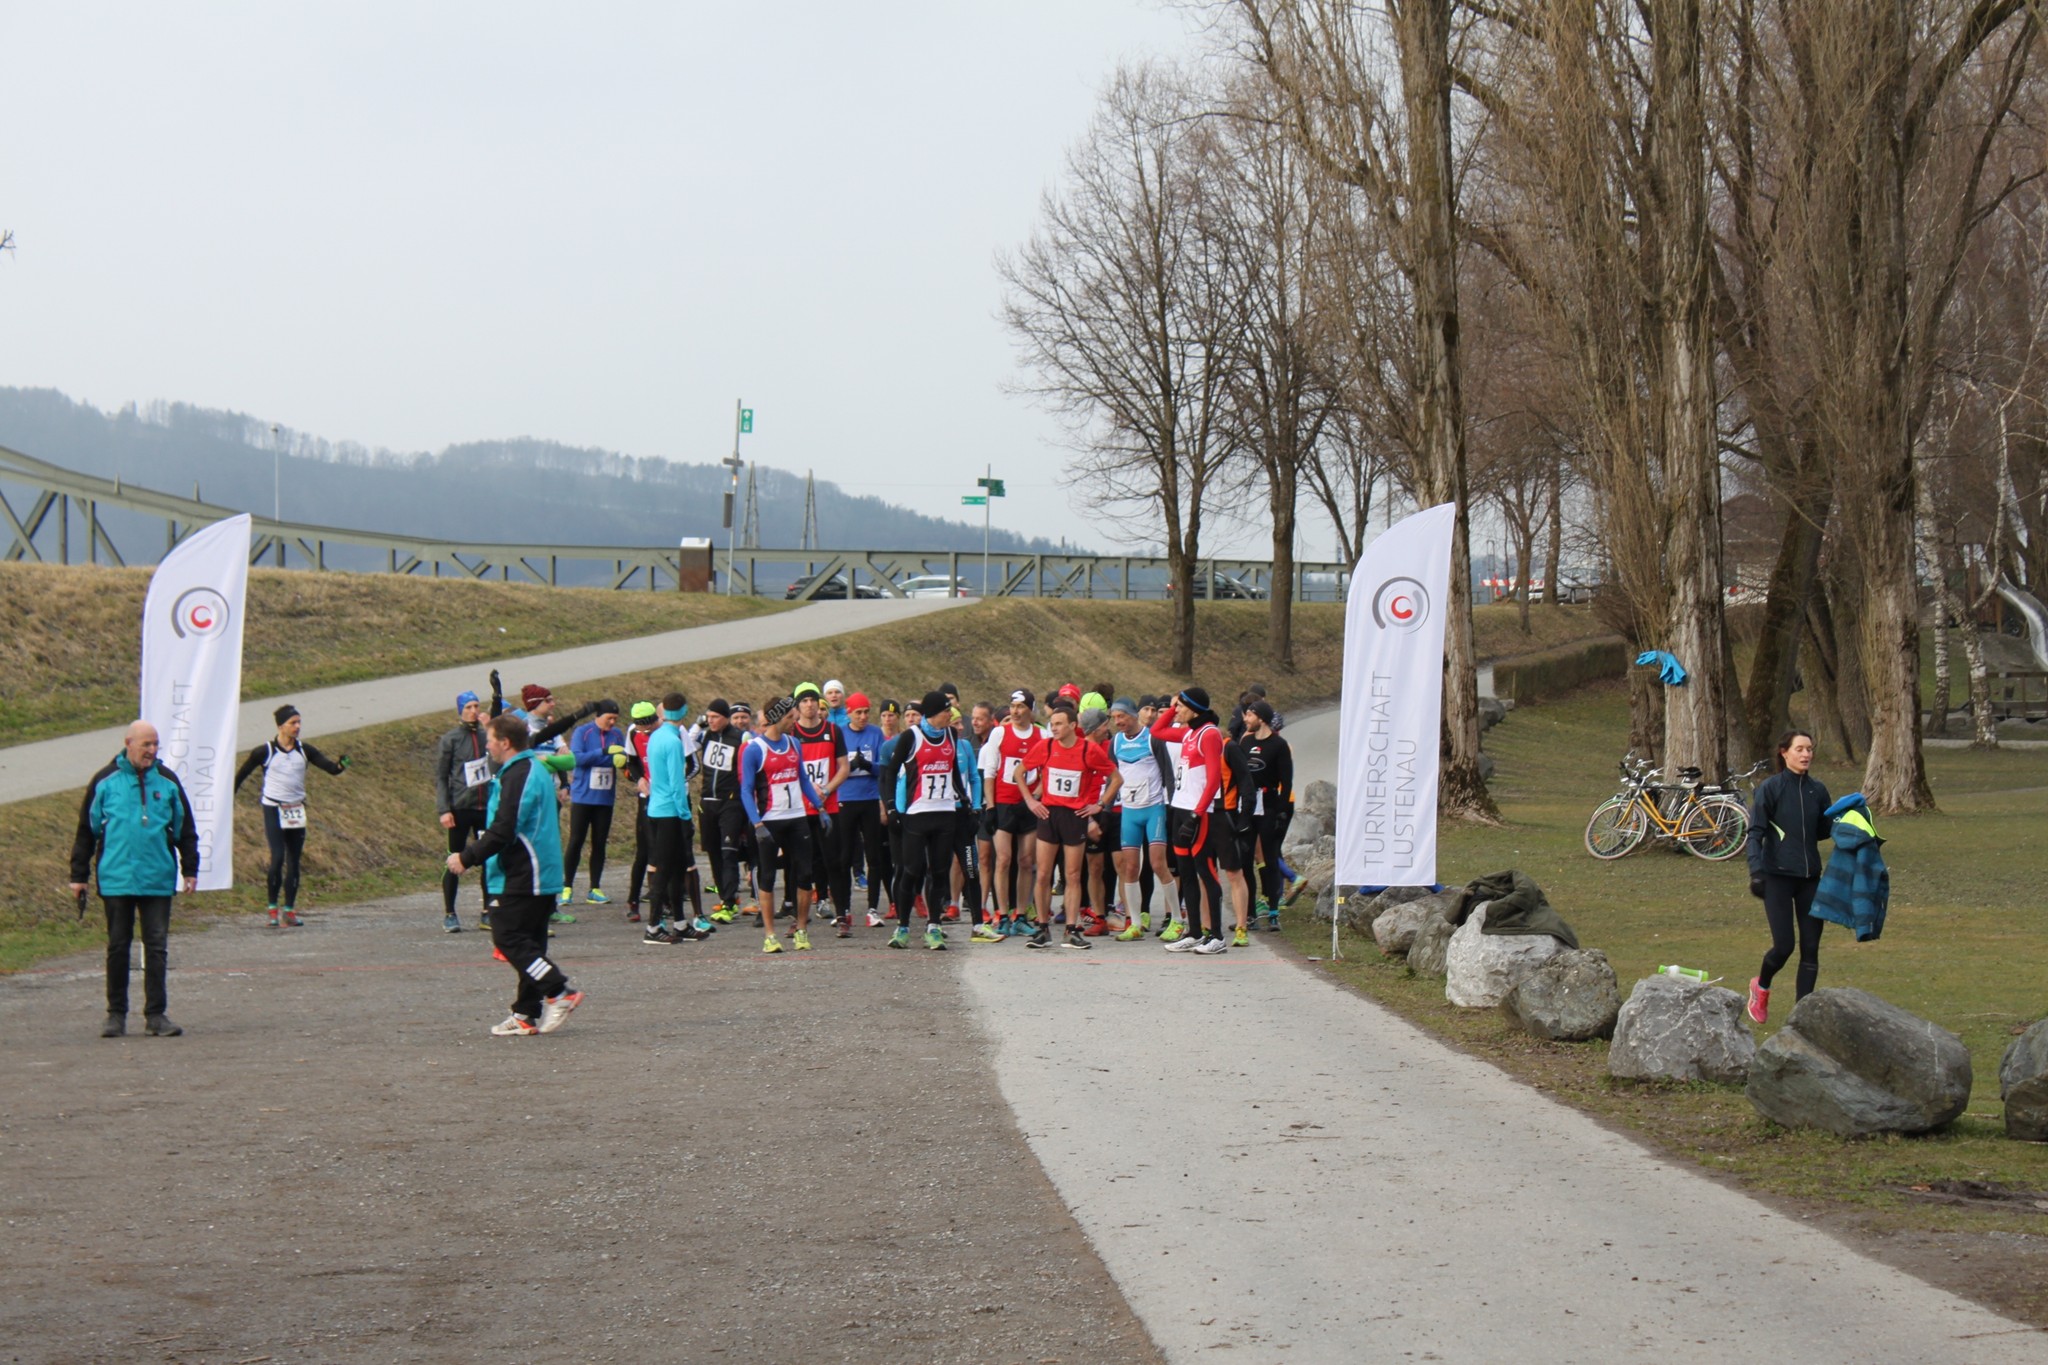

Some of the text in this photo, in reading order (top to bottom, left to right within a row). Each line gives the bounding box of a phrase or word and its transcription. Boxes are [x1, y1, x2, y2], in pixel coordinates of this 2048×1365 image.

[709, 743, 729, 767] 85
[597, 774, 609, 786] 11
[1363, 670, 1392, 869] TURNERSCHAFT
[783, 783, 792, 809] 1
[926, 774, 947, 800] 77
[1055, 778, 1073, 792] 19
[1130, 789, 1138, 802] 7
[1392, 738, 1417, 869] LUSTENAU
